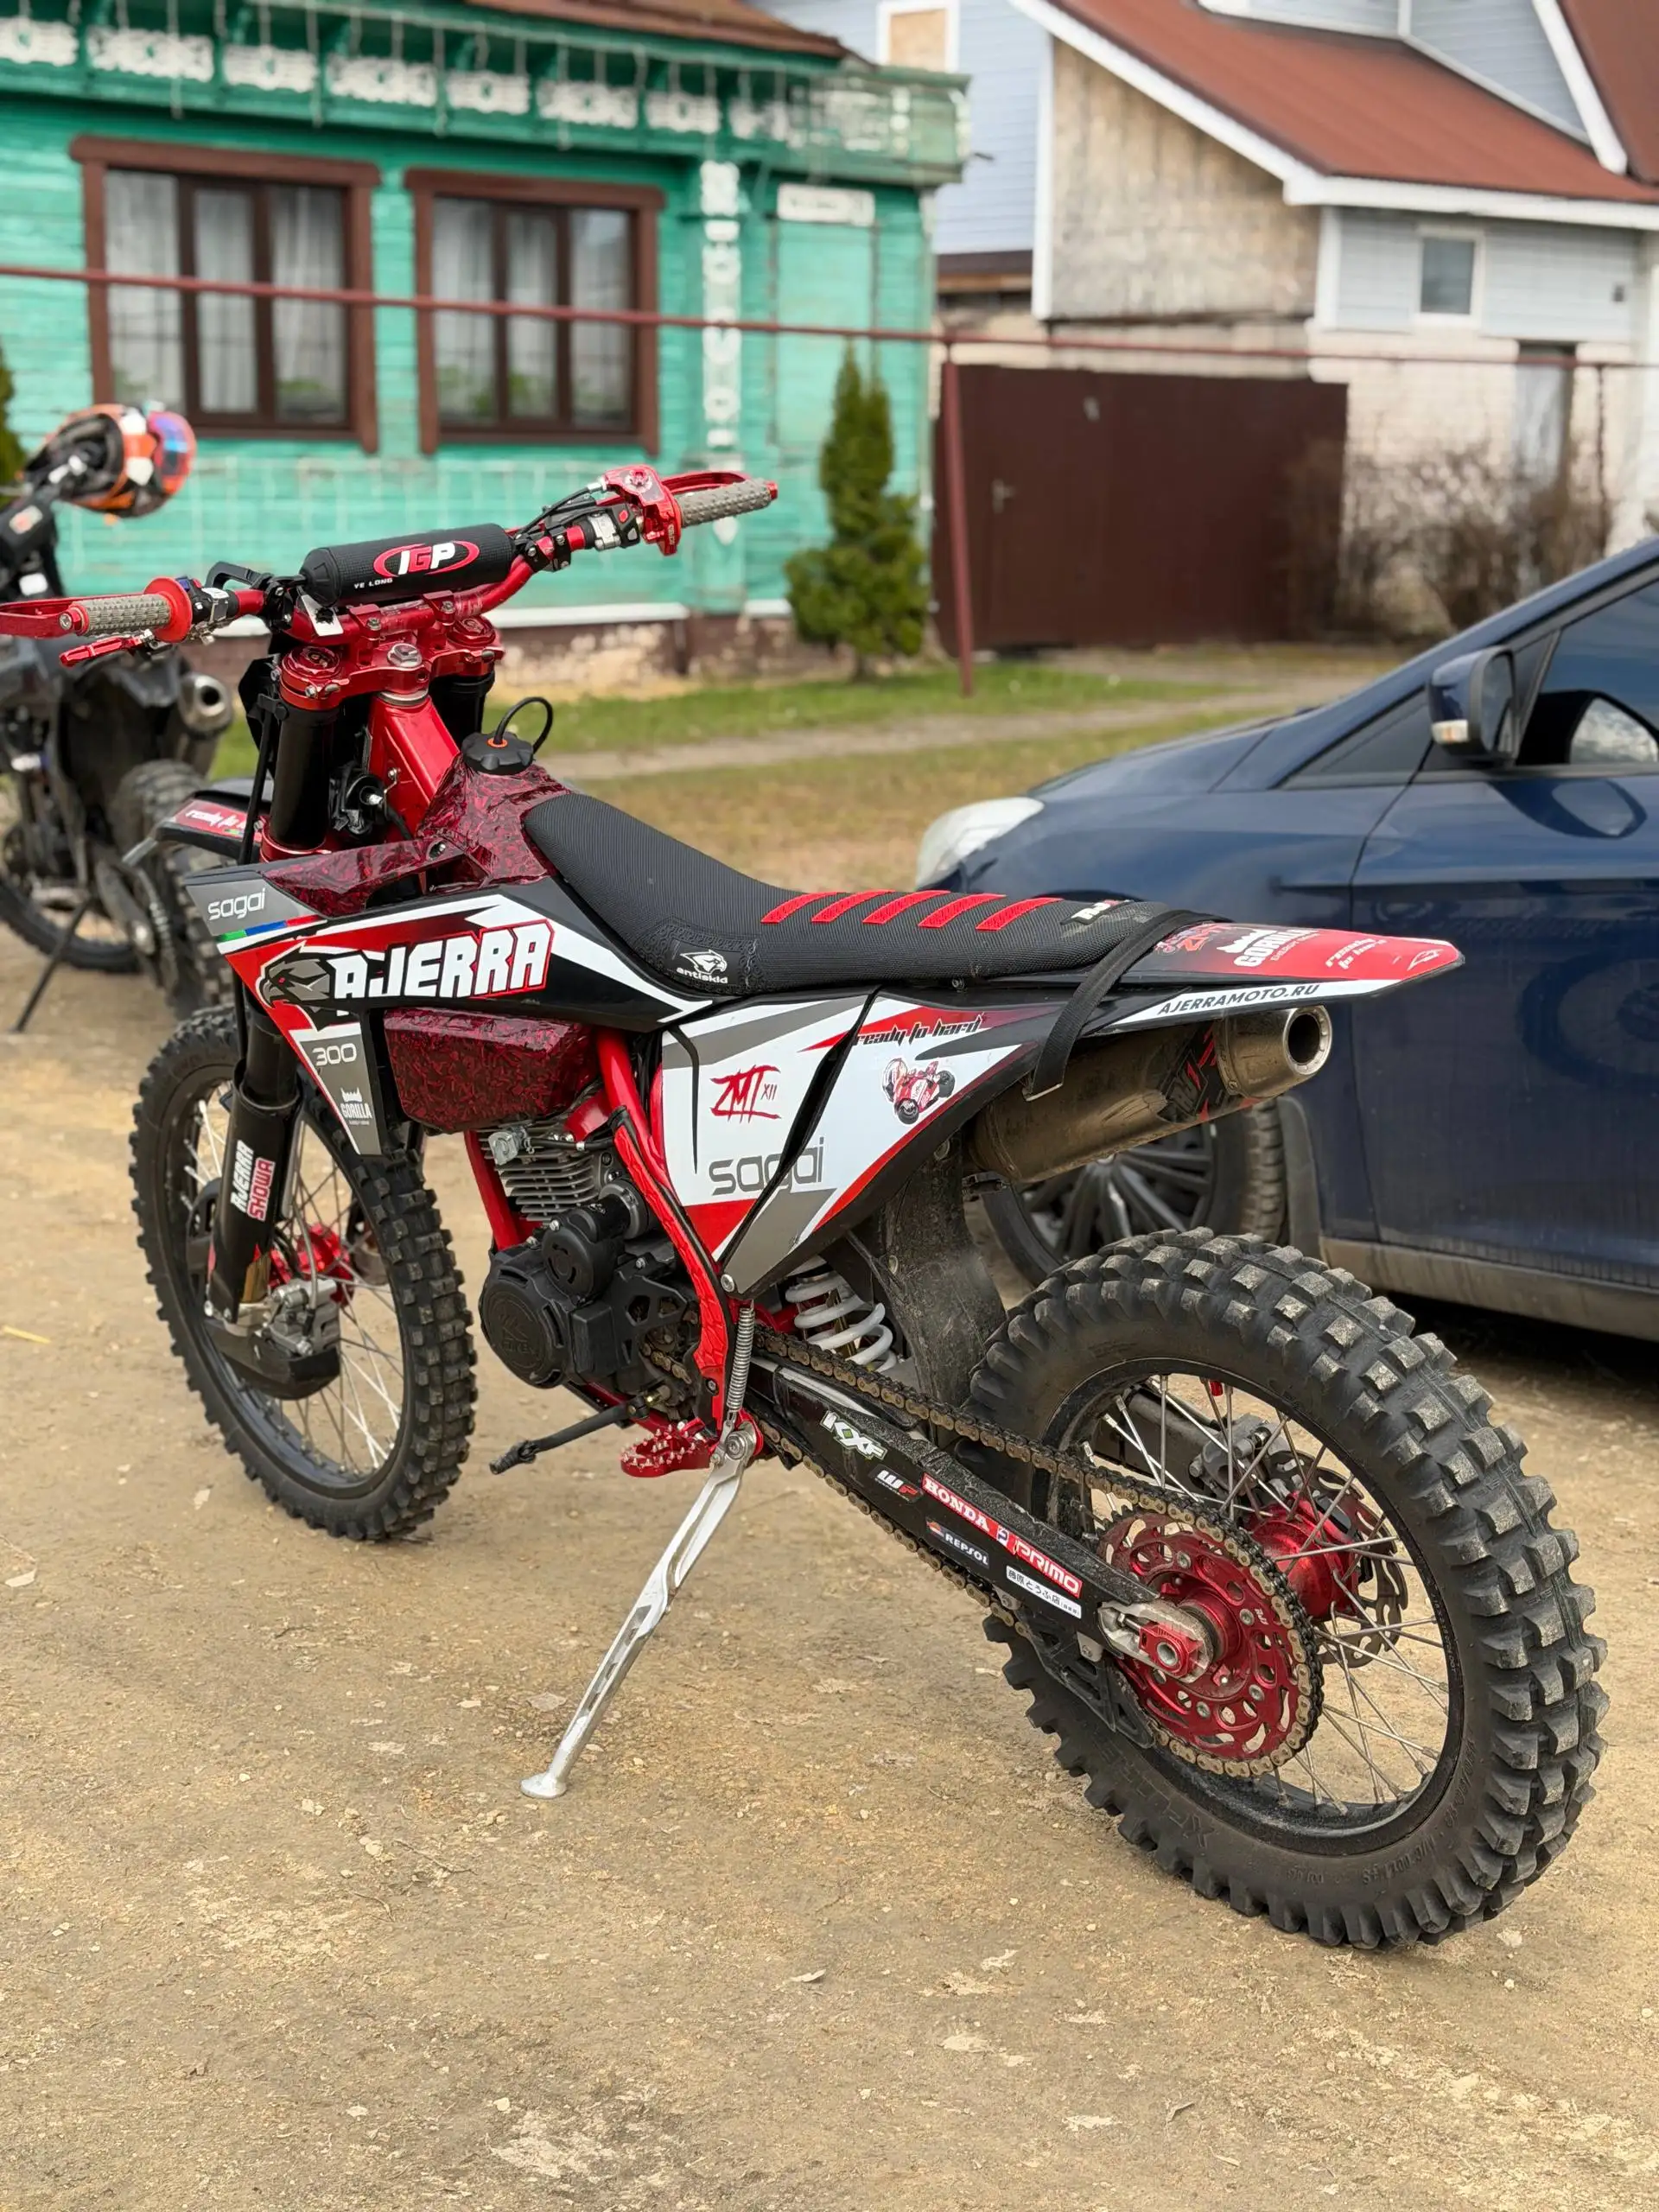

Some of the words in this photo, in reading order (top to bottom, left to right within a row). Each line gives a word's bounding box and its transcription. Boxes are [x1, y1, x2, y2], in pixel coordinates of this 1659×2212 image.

[368, 577, 393, 588] LONG
[207, 887, 265, 921] sagai
[327, 920, 555, 1000] AJERRA
[676, 967, 728, 984] antiskid
[1157, 983, 1320, 1016] AJERRAMOTO.RU
[312, 1042, 358, 1067] 300
[760, 1083, 779, 1102] XII
[340, 1103, 373, 1119] GORILLA
[230, 1139, 255, 1214] AJERRA
[247, 1156, 276, 1222] SHOWA
[924, 1477, 990, 1533] HONDA
[1015, 1538, 1079, 1595] PRIMO
[944, 1531, 989, 1566] REPSOL
